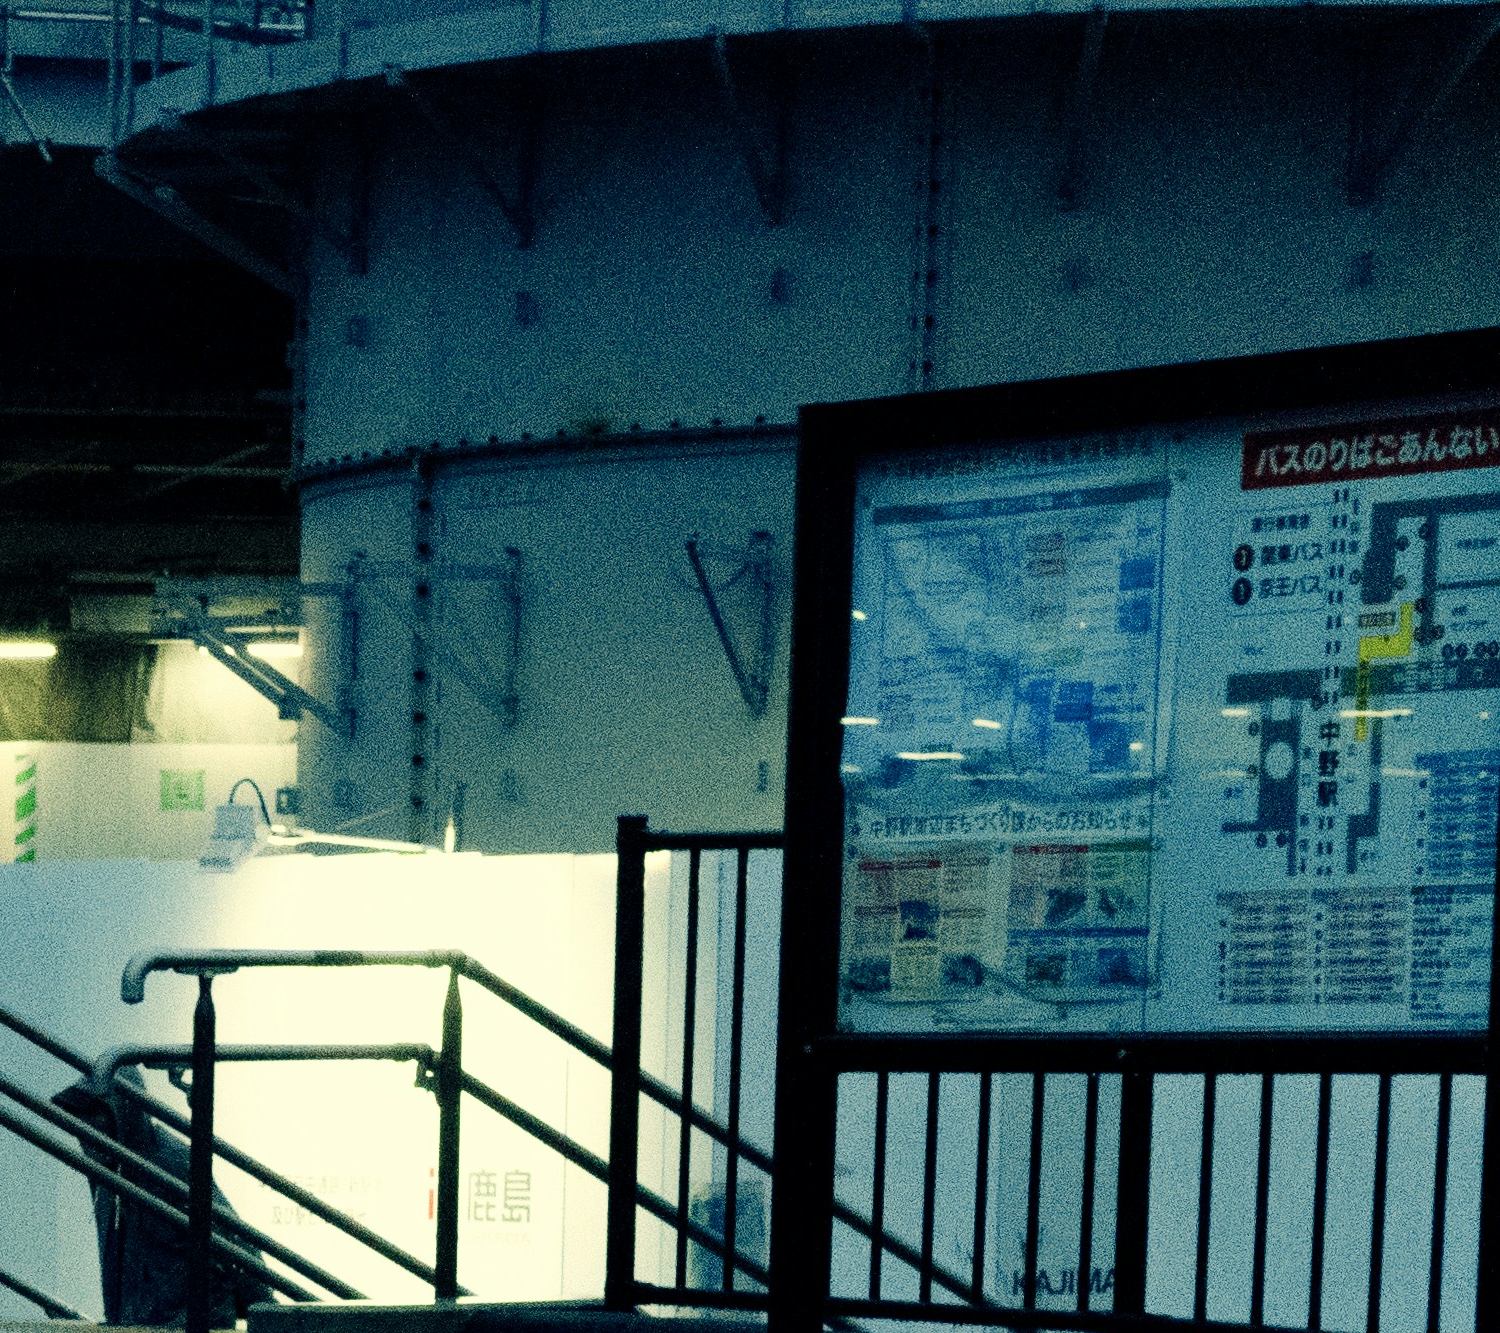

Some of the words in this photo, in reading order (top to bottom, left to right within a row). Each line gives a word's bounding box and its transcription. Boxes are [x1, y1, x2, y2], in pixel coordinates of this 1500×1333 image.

[1255, 425, 1500, 476] バスのりばごあんない
[1259, 575, 1323, 599] 京王バス
[1317, 721, 1340, 807] 中野駅
[468, 1169, 531, 1223] 鹿島
